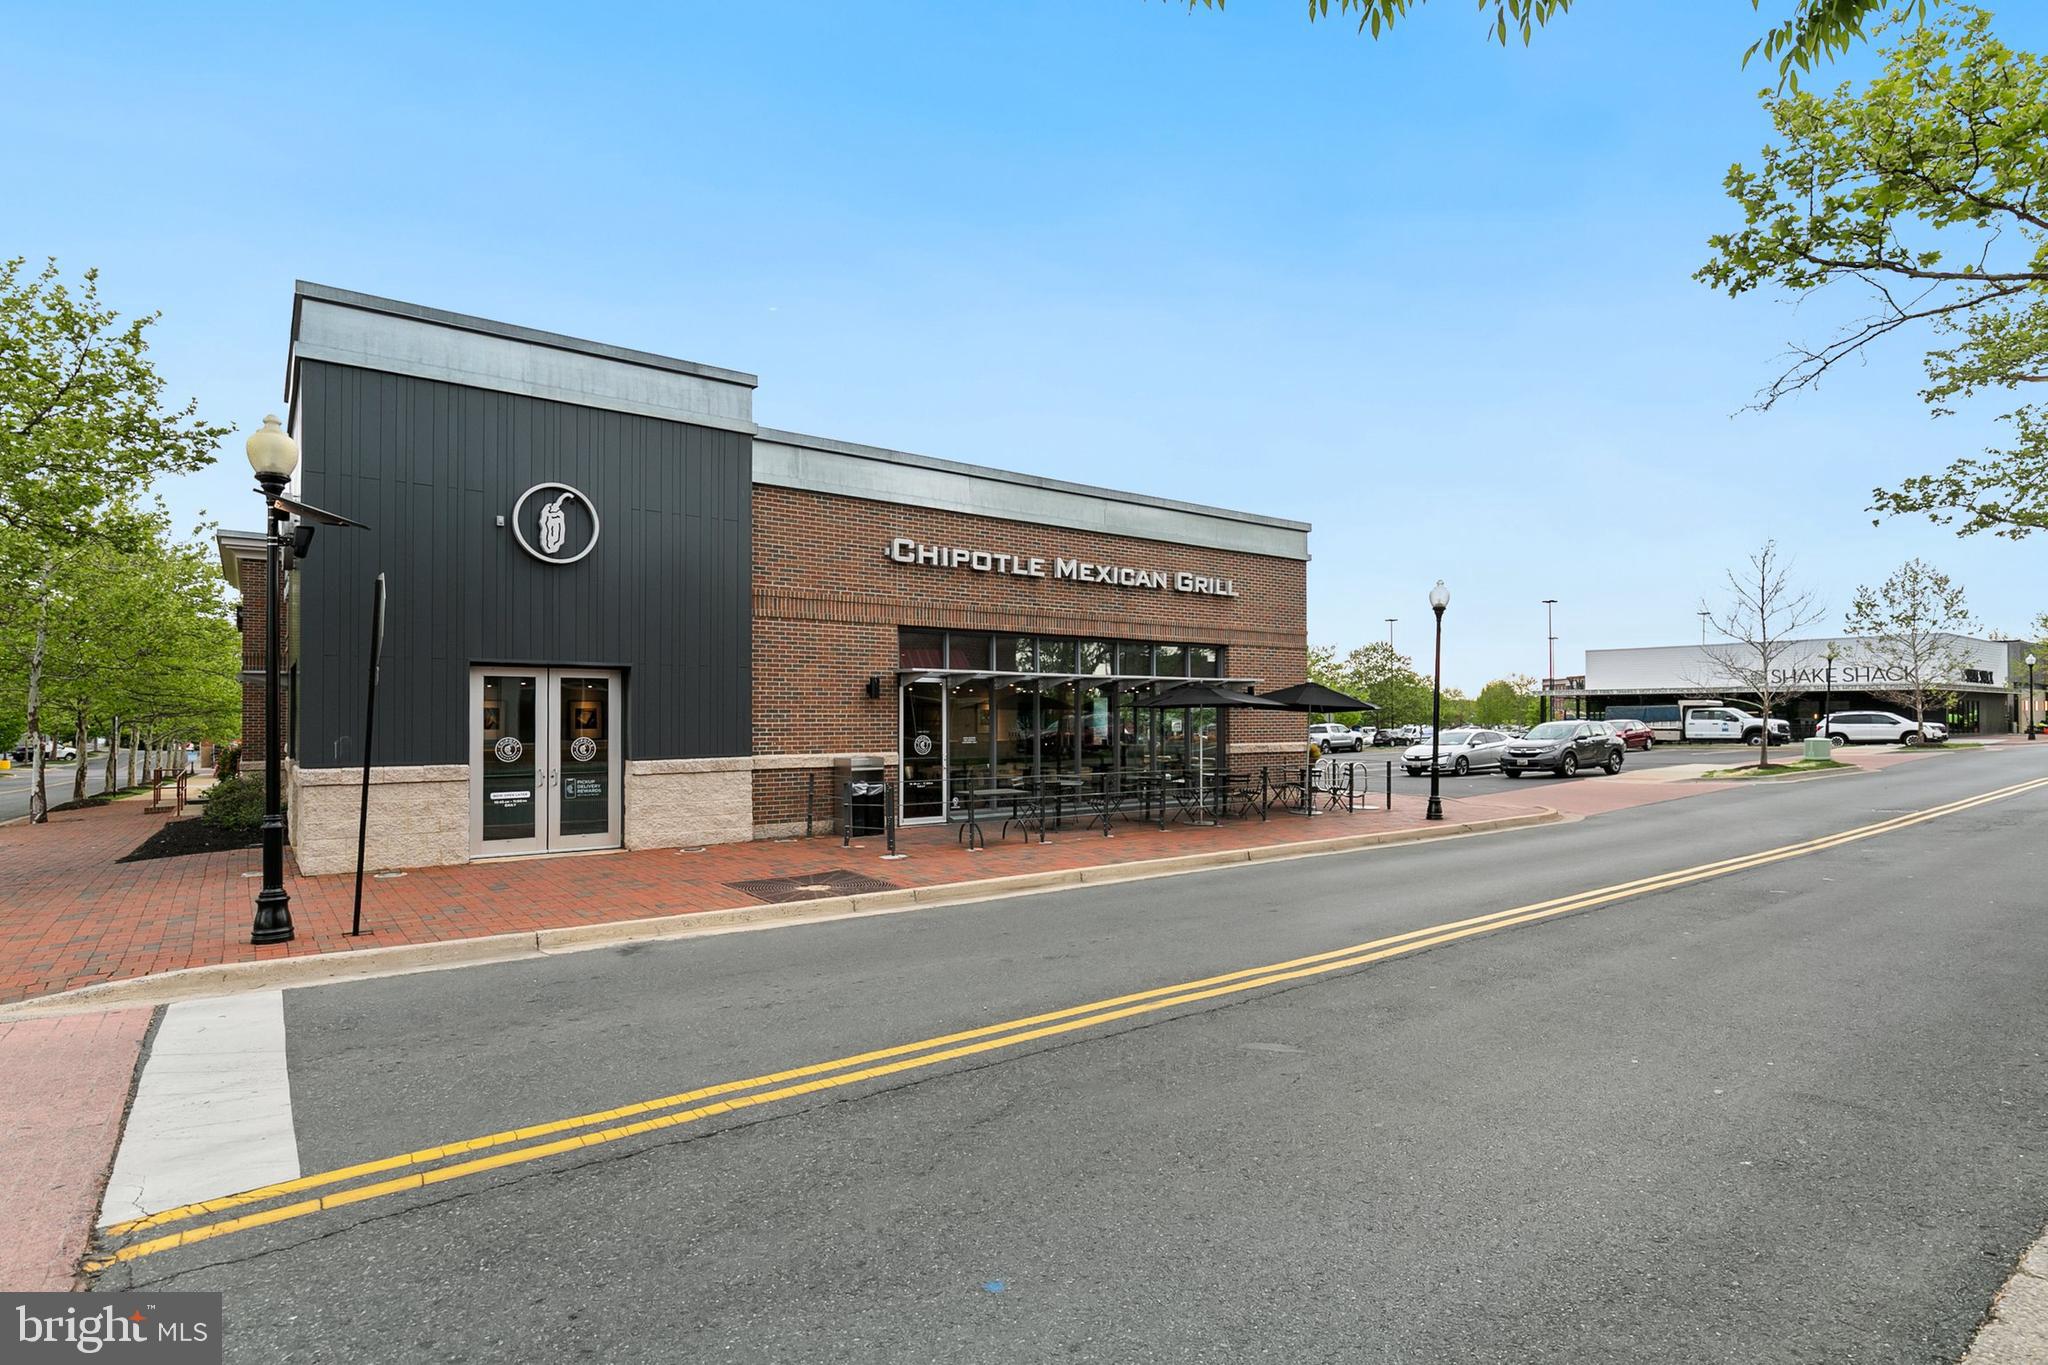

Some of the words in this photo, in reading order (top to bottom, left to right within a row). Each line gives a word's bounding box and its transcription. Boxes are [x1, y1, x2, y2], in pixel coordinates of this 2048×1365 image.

[891, 537, 1045, 578] CHIPOTLE
[1054, 557, 1167, 589] MEXICAN
[1174, 571, 1239, 597] GRILL
[1771, 667, 1837, 684] SHAKE
[1842, 665, 1917, 683] SHACK
